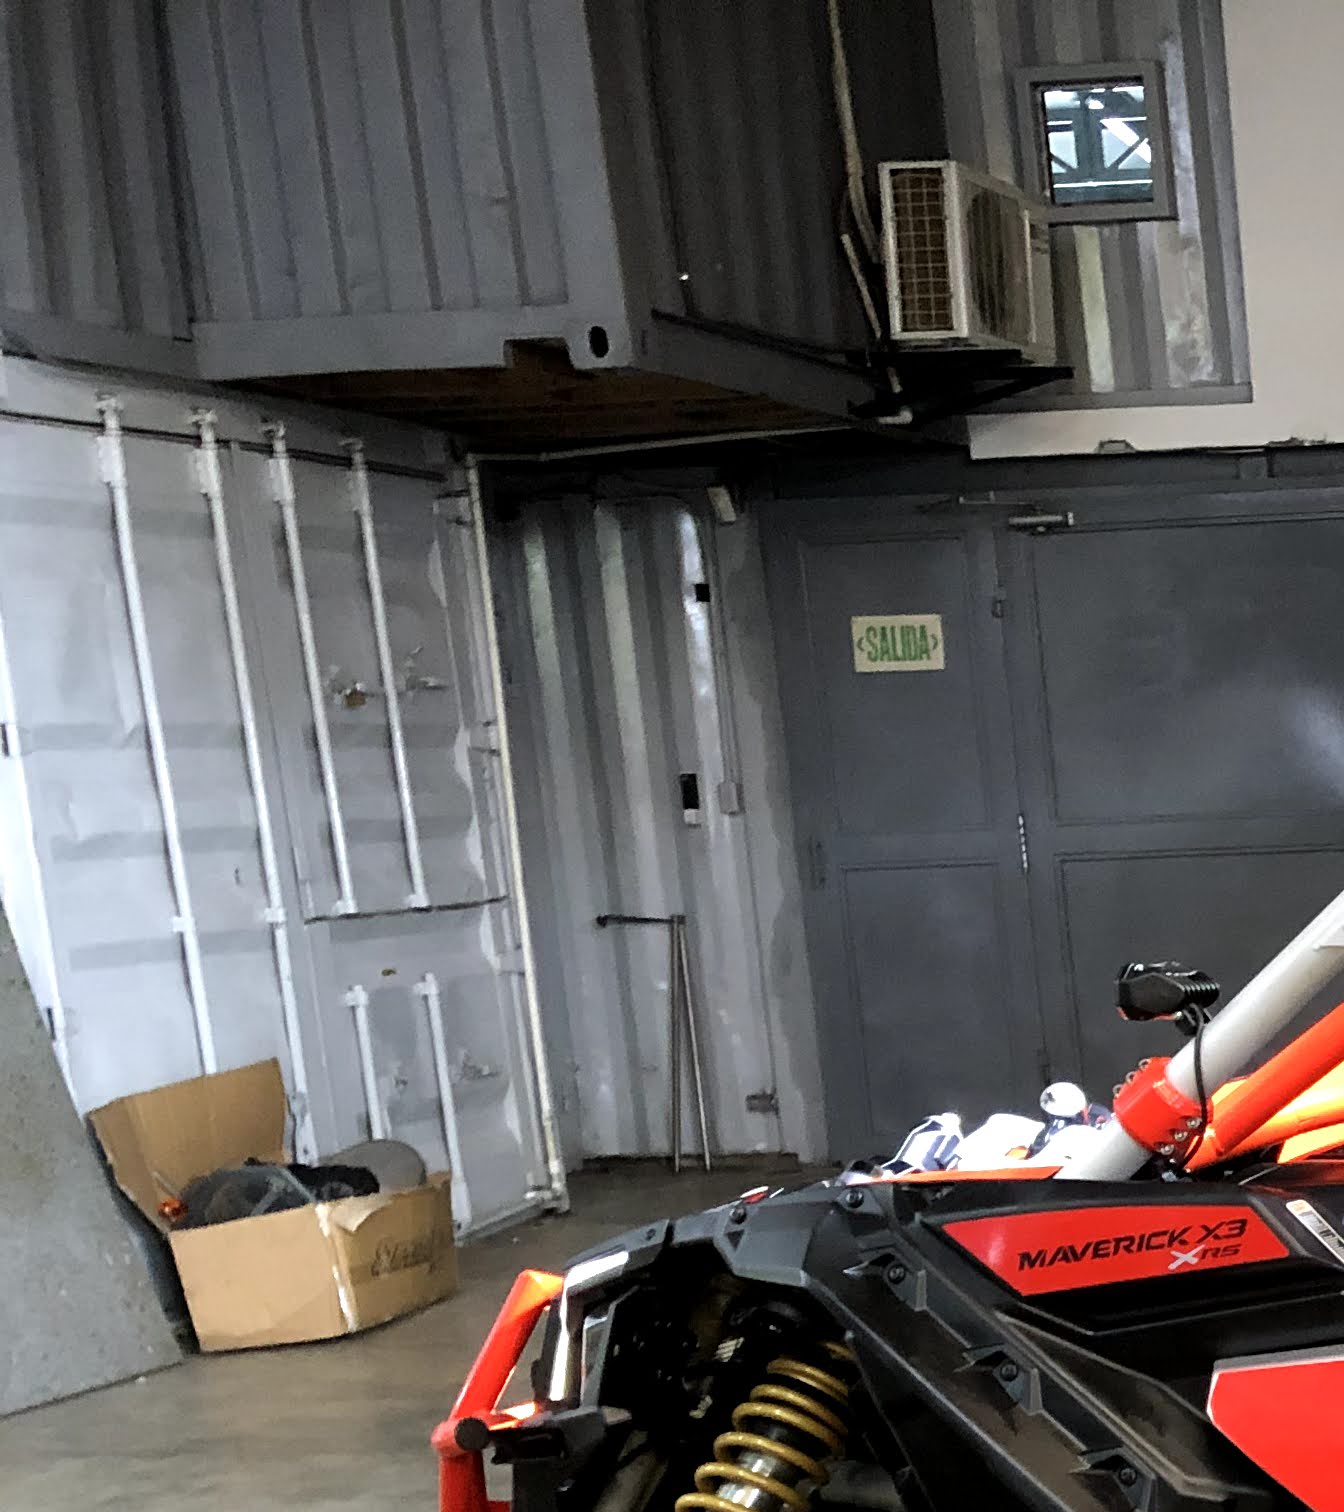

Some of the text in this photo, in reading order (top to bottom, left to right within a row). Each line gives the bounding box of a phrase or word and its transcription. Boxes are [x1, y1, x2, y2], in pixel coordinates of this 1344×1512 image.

[865, 625, 931, 662] SALIDA
[1017, 1225, 1193, 1271] MAVERICK
[1196, 1218, 1248, 1244] X3
